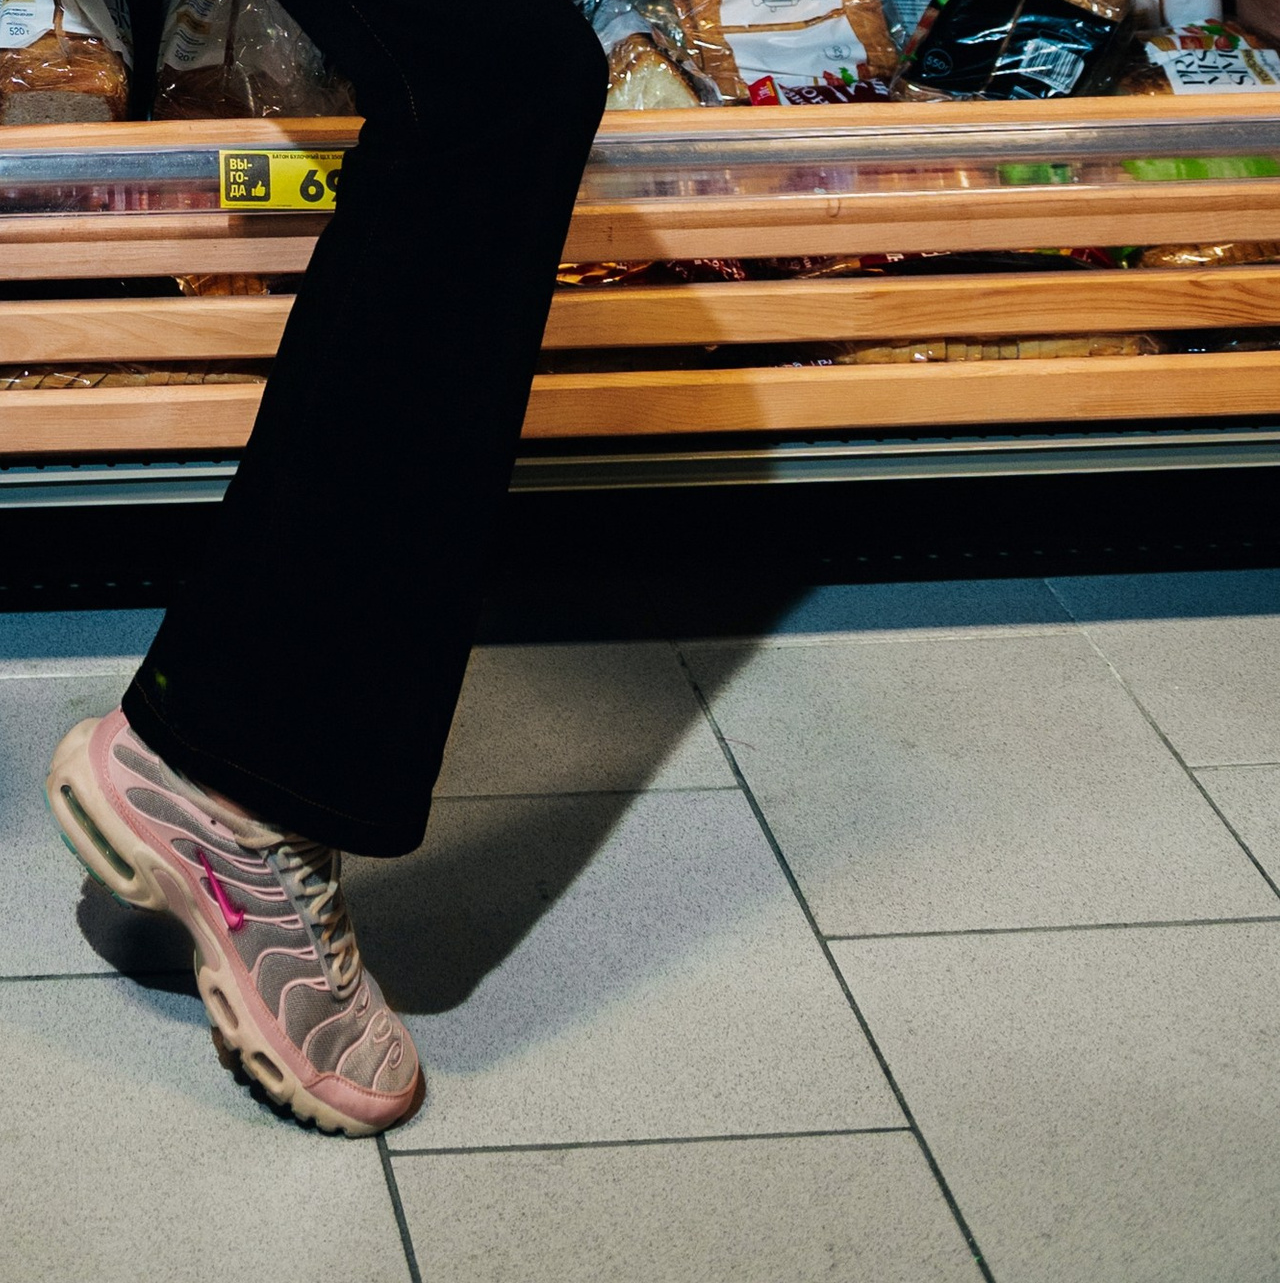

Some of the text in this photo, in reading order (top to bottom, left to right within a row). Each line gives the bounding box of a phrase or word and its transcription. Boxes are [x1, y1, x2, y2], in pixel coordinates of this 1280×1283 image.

[10, 27, 24, 35] 520
[175, 50, 189, 61] 520
[230, 159, 252, 169] ВЫ-
[230, 172, 248, 182] ГО-
[230, 185, 246, 197] ДА
